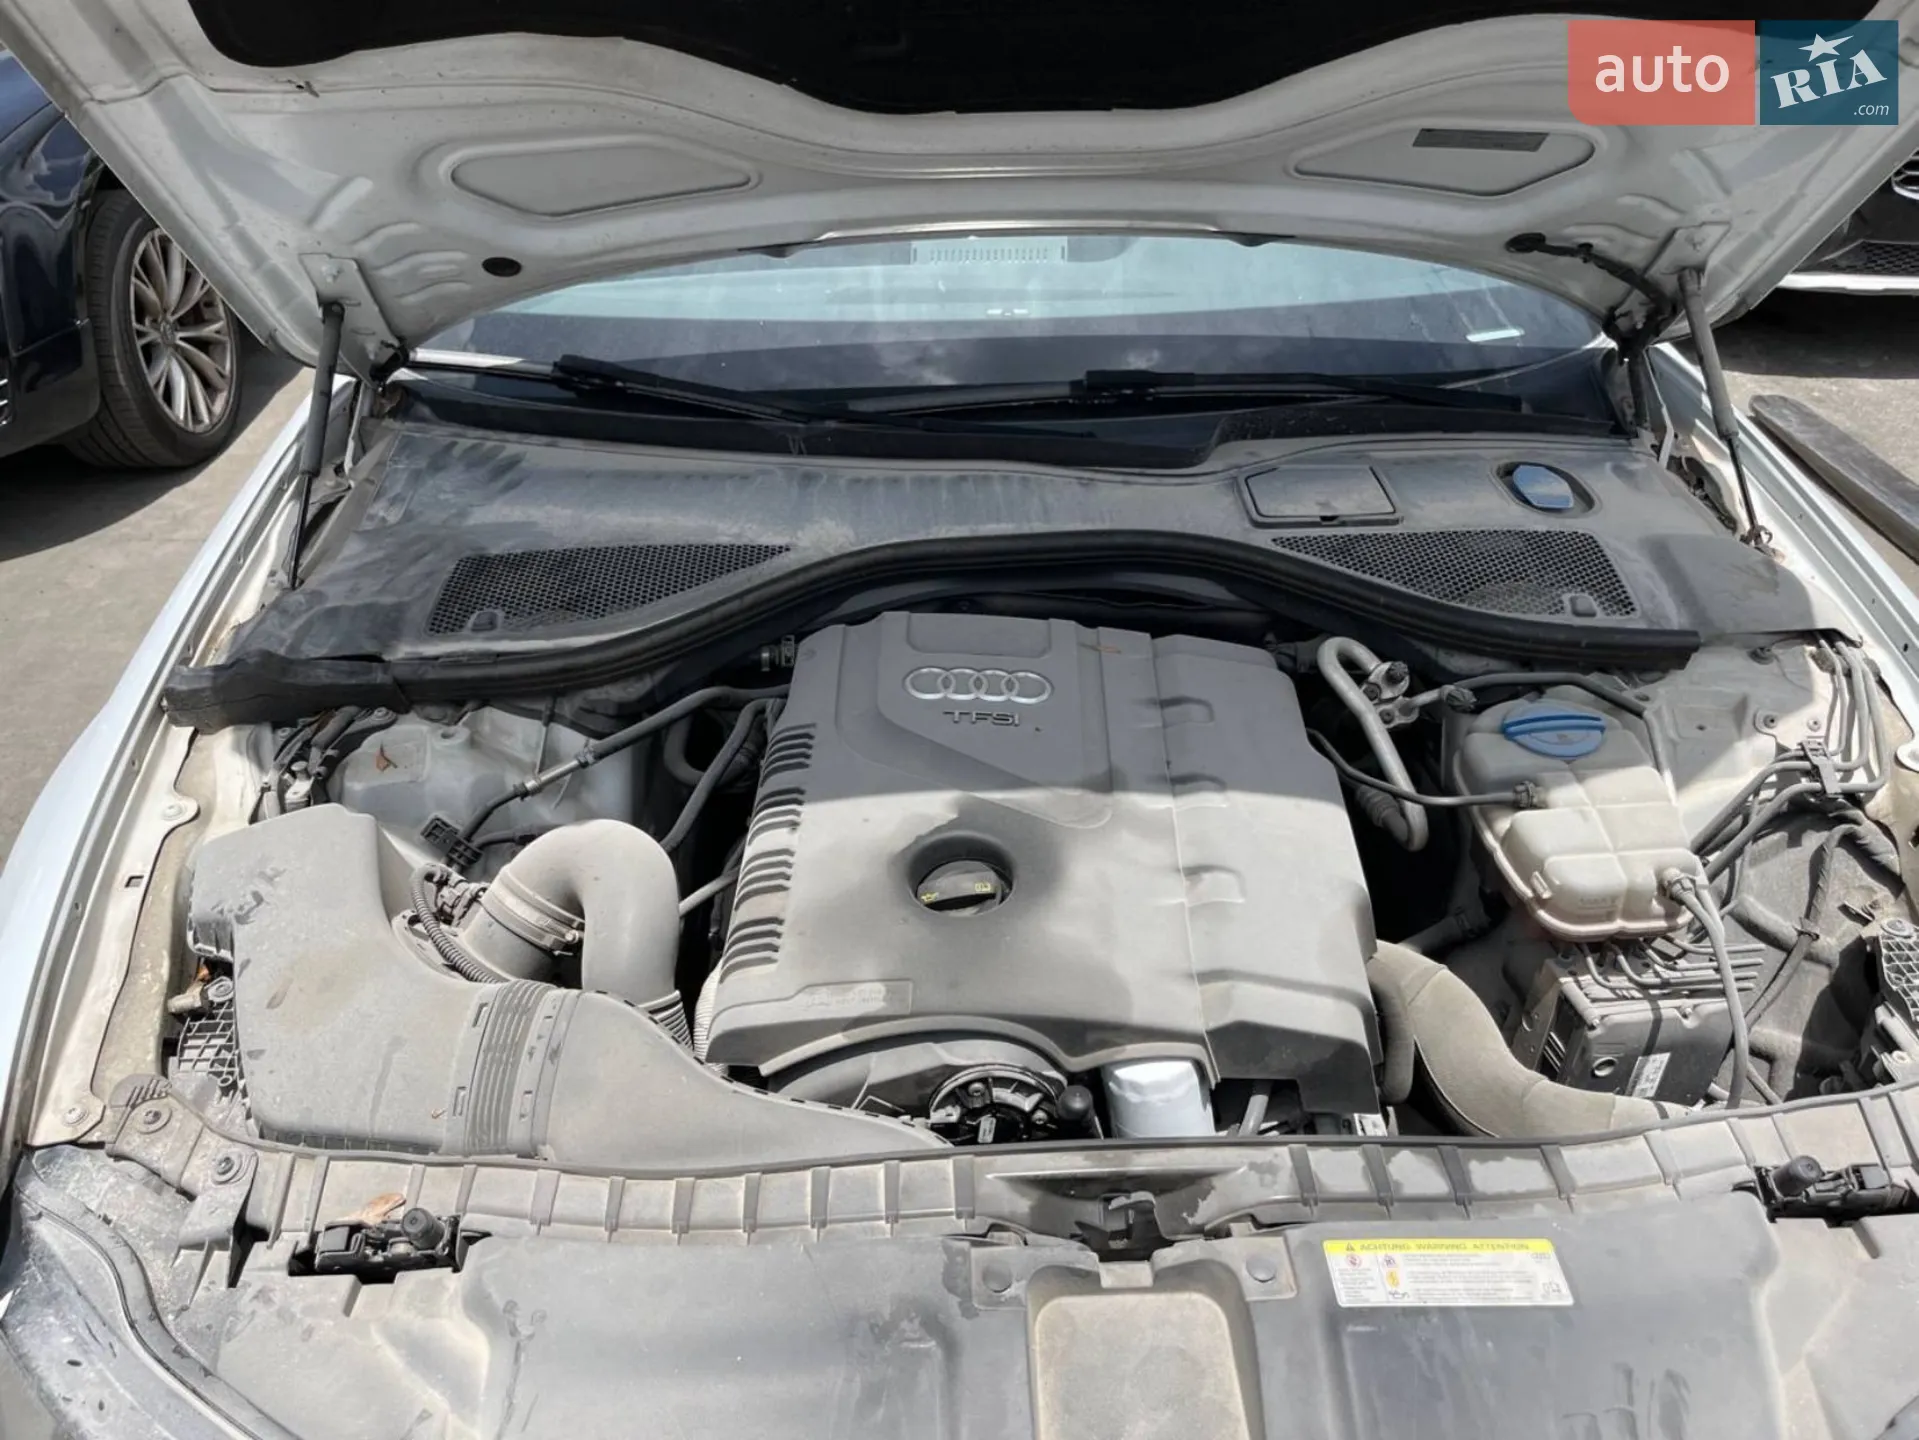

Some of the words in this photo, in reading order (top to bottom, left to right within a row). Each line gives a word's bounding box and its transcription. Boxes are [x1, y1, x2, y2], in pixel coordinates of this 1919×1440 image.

[943, 710, 1020, 727] TFSI
[1360, 1242, 1411, 1252] ACHTUNG
[1415, 1242, 1467, 1252] WARNING
[1472, 1242, 1530, 1252] ATTENTION
